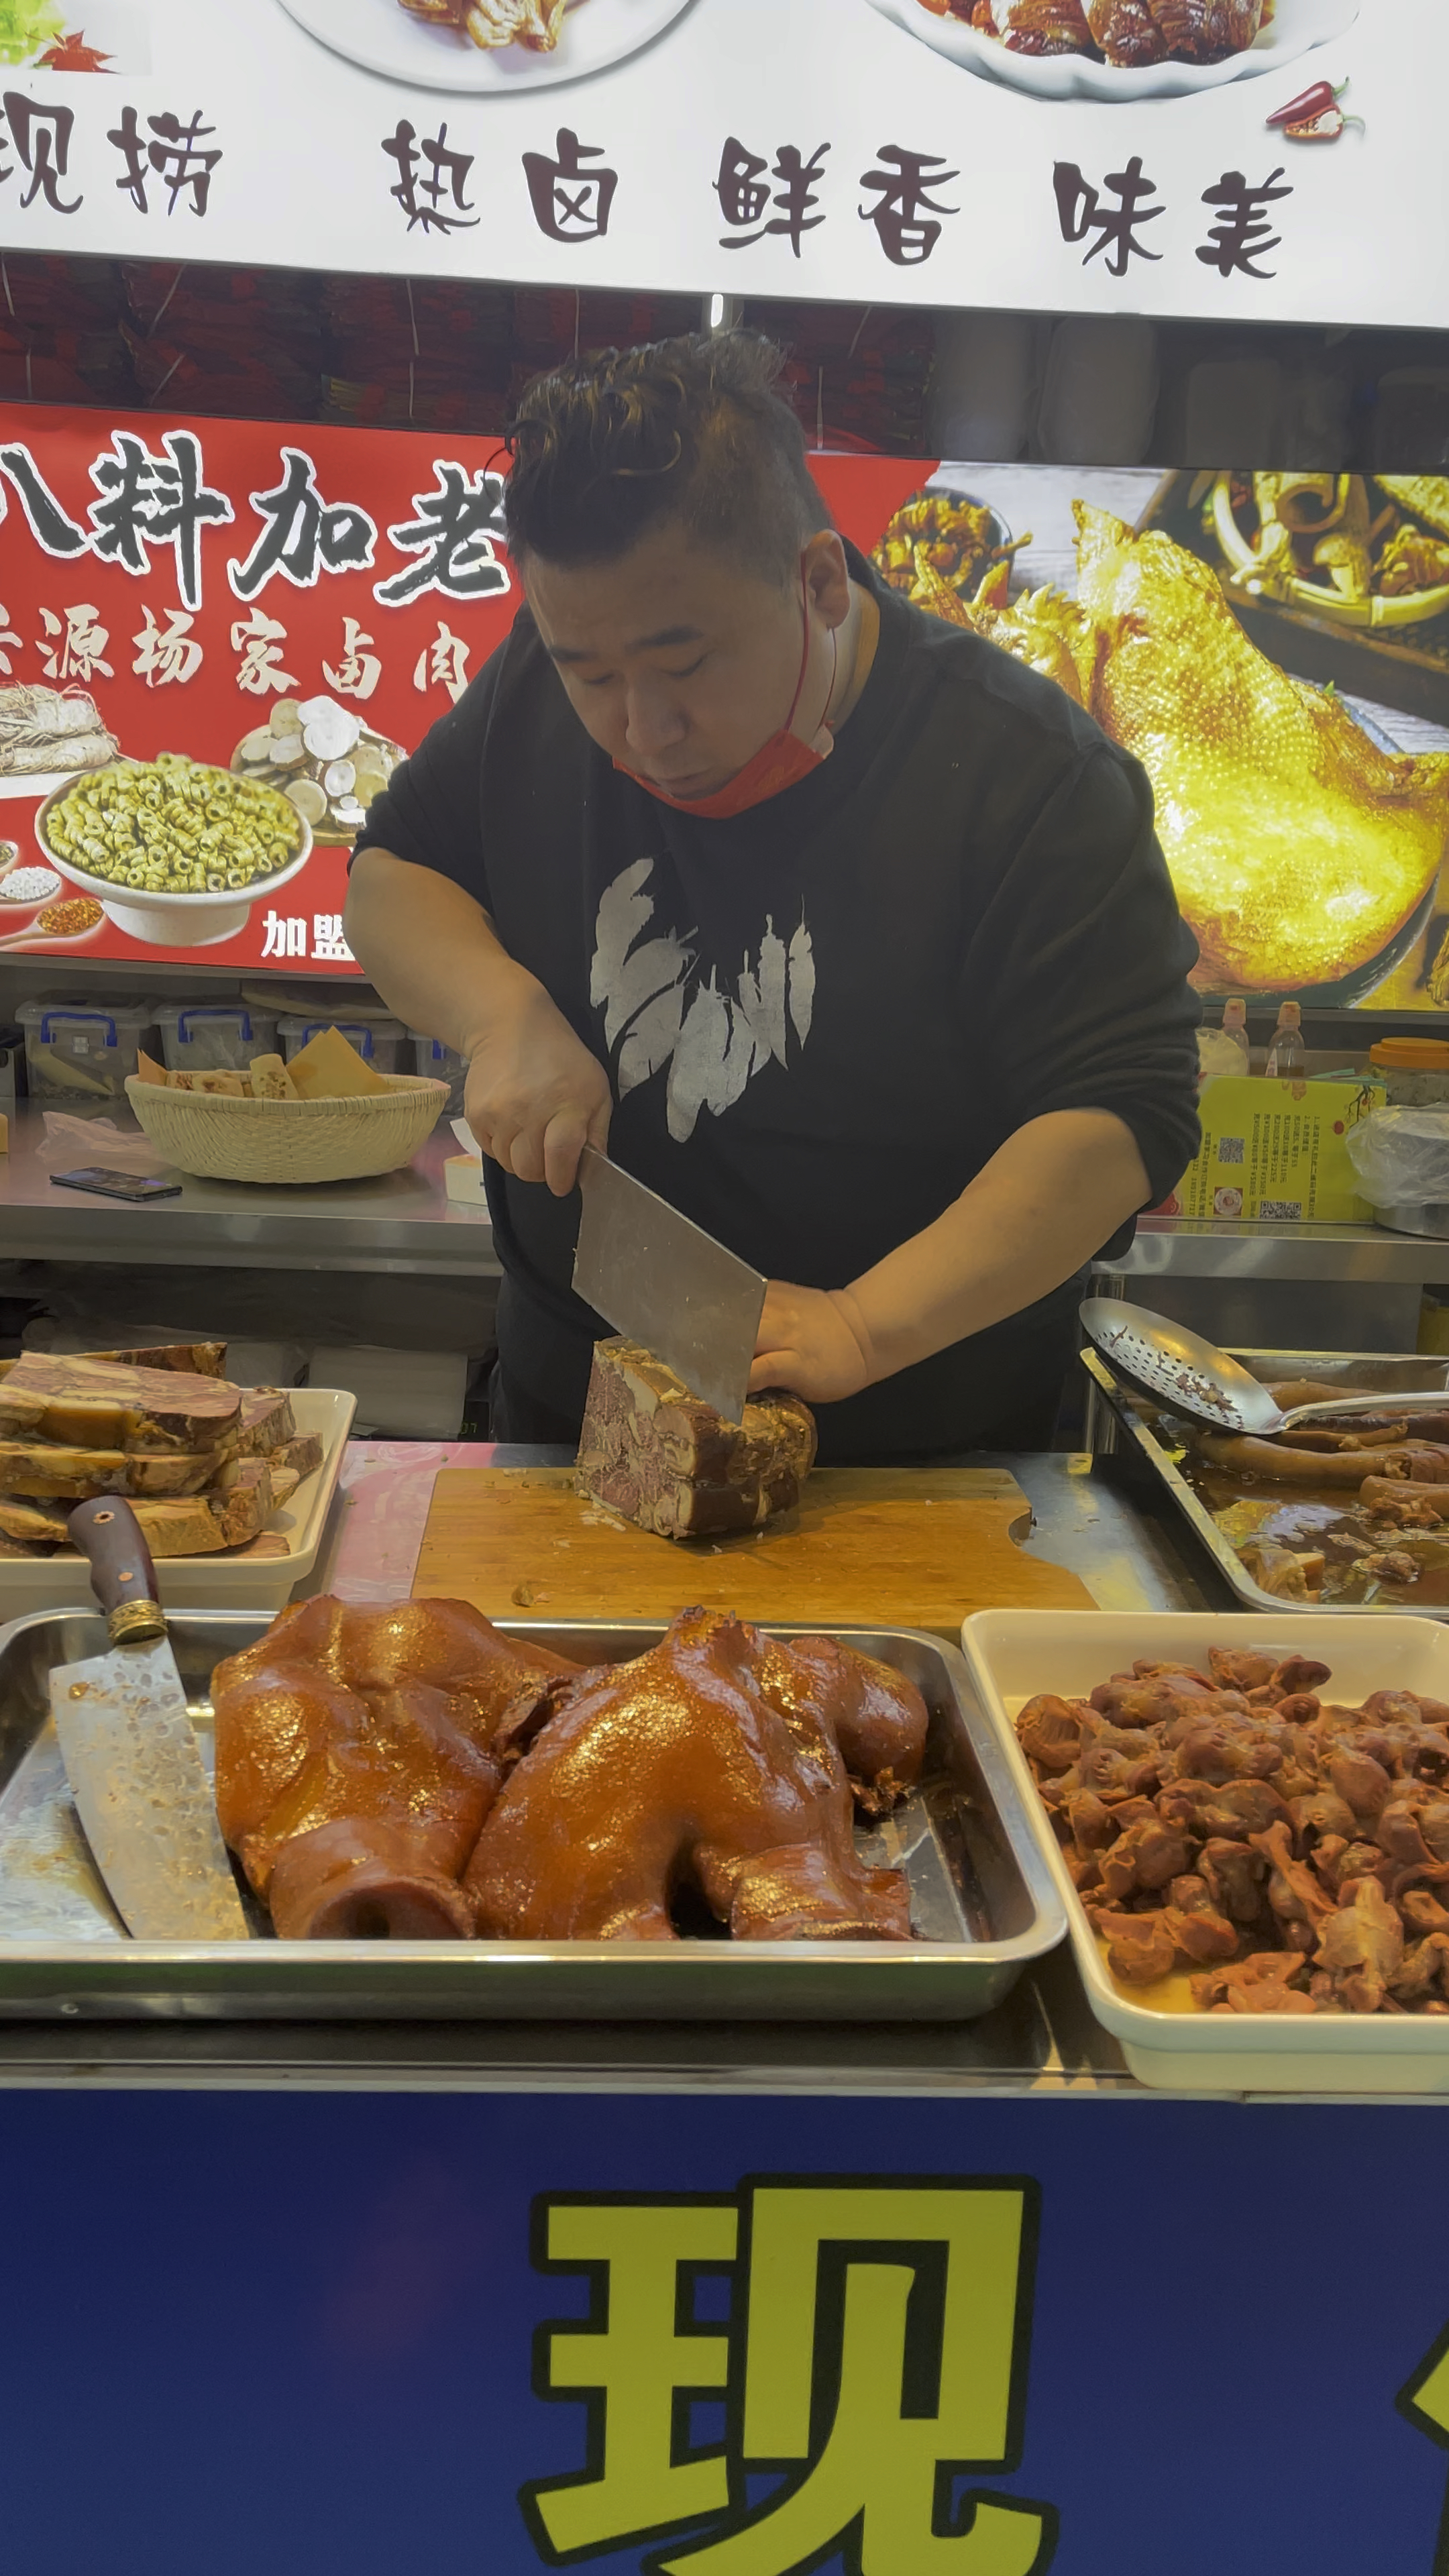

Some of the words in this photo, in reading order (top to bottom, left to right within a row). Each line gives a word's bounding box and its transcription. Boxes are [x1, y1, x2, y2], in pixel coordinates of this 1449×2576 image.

[380, 119, 618, 243] 热卤
[712, 136, 961, 266] 鲜香
[1053, 156, 1293, 279] 味美
[533, 2186, 1044, 2576] 现
